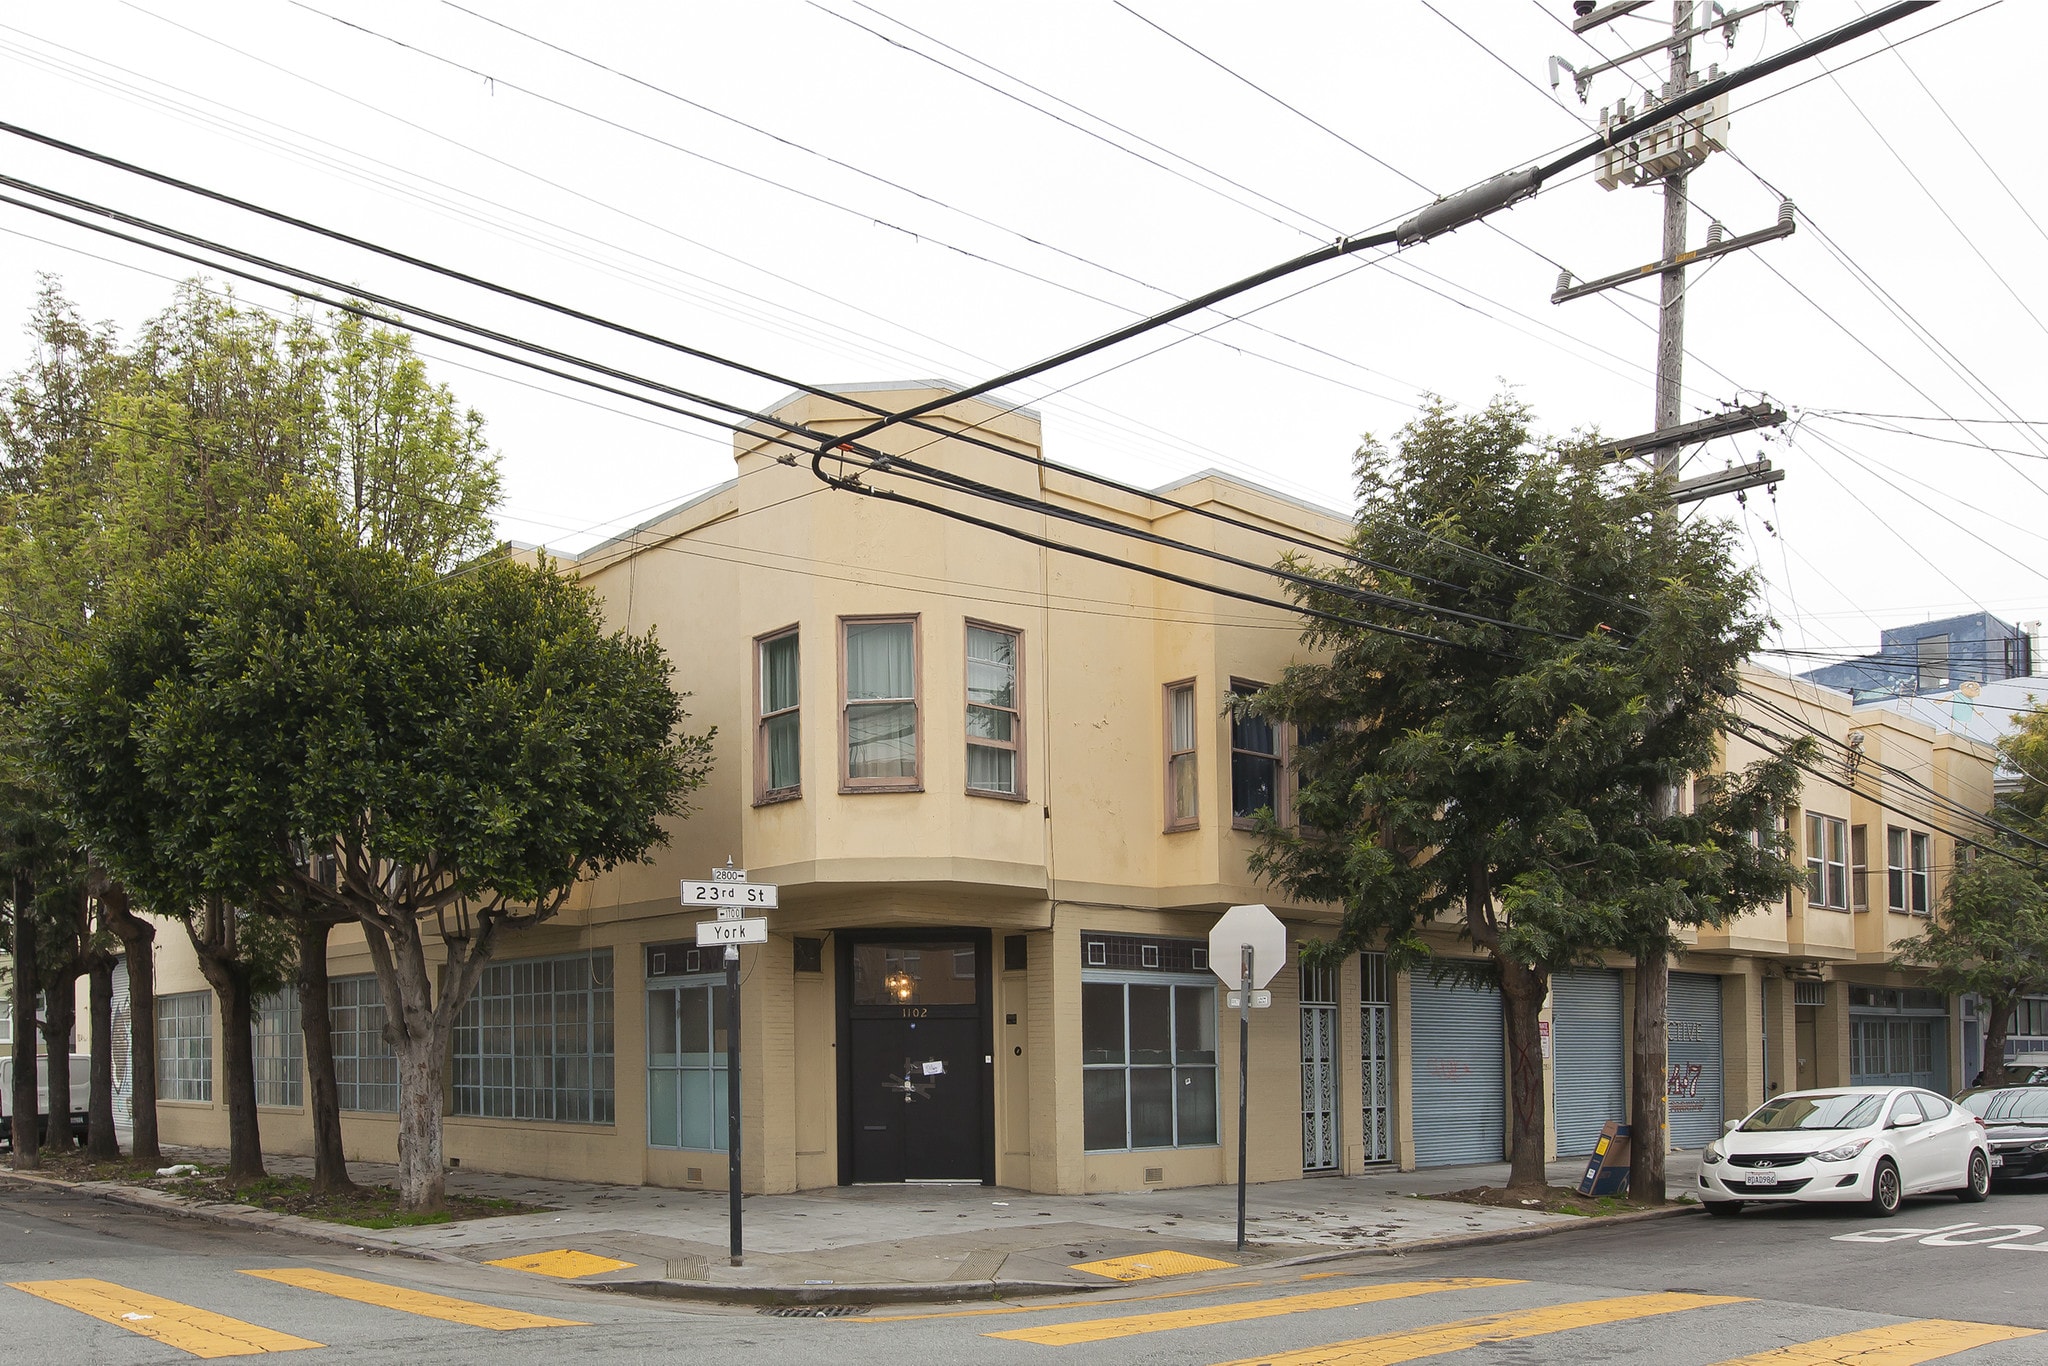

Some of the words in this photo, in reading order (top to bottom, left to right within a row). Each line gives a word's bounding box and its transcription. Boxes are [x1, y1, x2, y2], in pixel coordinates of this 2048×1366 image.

[716, 870, 738, 880] 2800
[696, 886, 735, 900] 23rd
[747, 888, 764, 902] St
[725, 908, 740, 918] 1100
[714, 925, 746, 939] York
[902, 1008, 928, 1018] 1102
[1667, 1021, 1703, 1042] CTIVE
